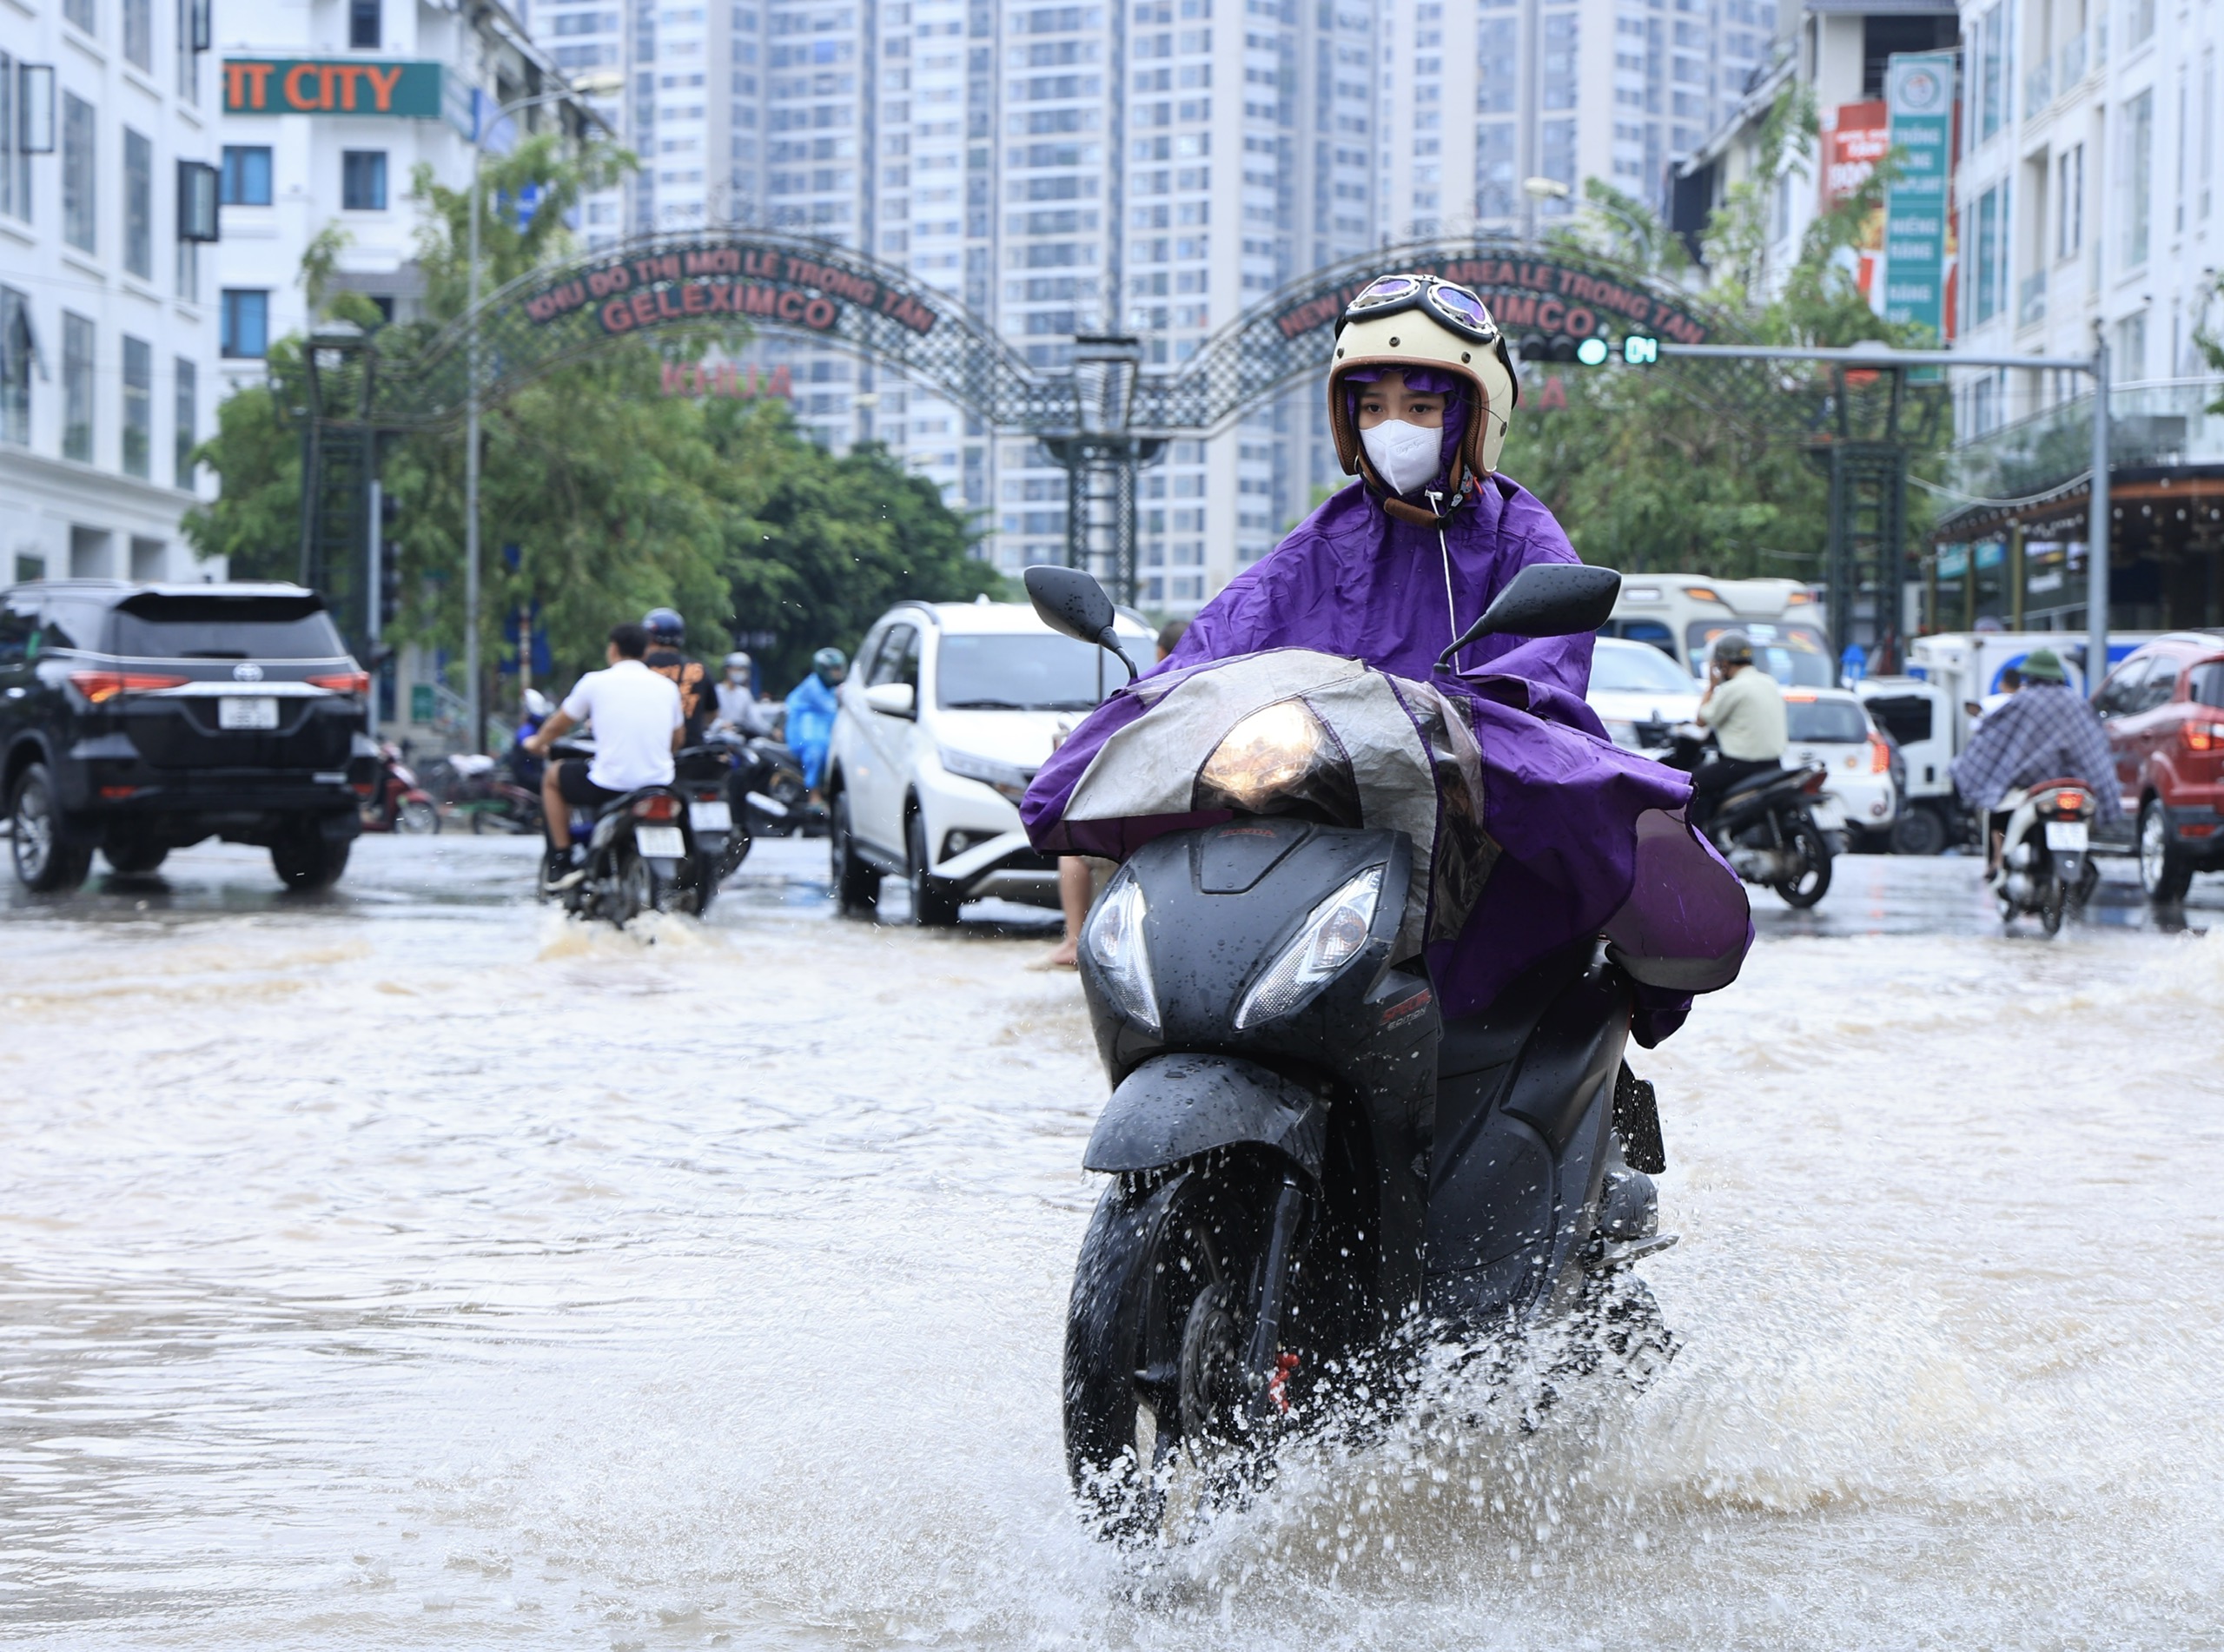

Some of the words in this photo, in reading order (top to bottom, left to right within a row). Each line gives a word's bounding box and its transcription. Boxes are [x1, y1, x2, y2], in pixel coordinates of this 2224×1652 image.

[223, 63, 275, 109] IT
[283, 63, 402, 111] CITY
[602, 283, 836, 332] GELEXIMCO
[1279, 291, 1340, 339] NEW
[1445, 261, 1517, 284] AREA
[661, 360, 758, 399] KHU
[767, 363, 793, 399] A
[1387, 1007, 1426, 1031] EDITION
